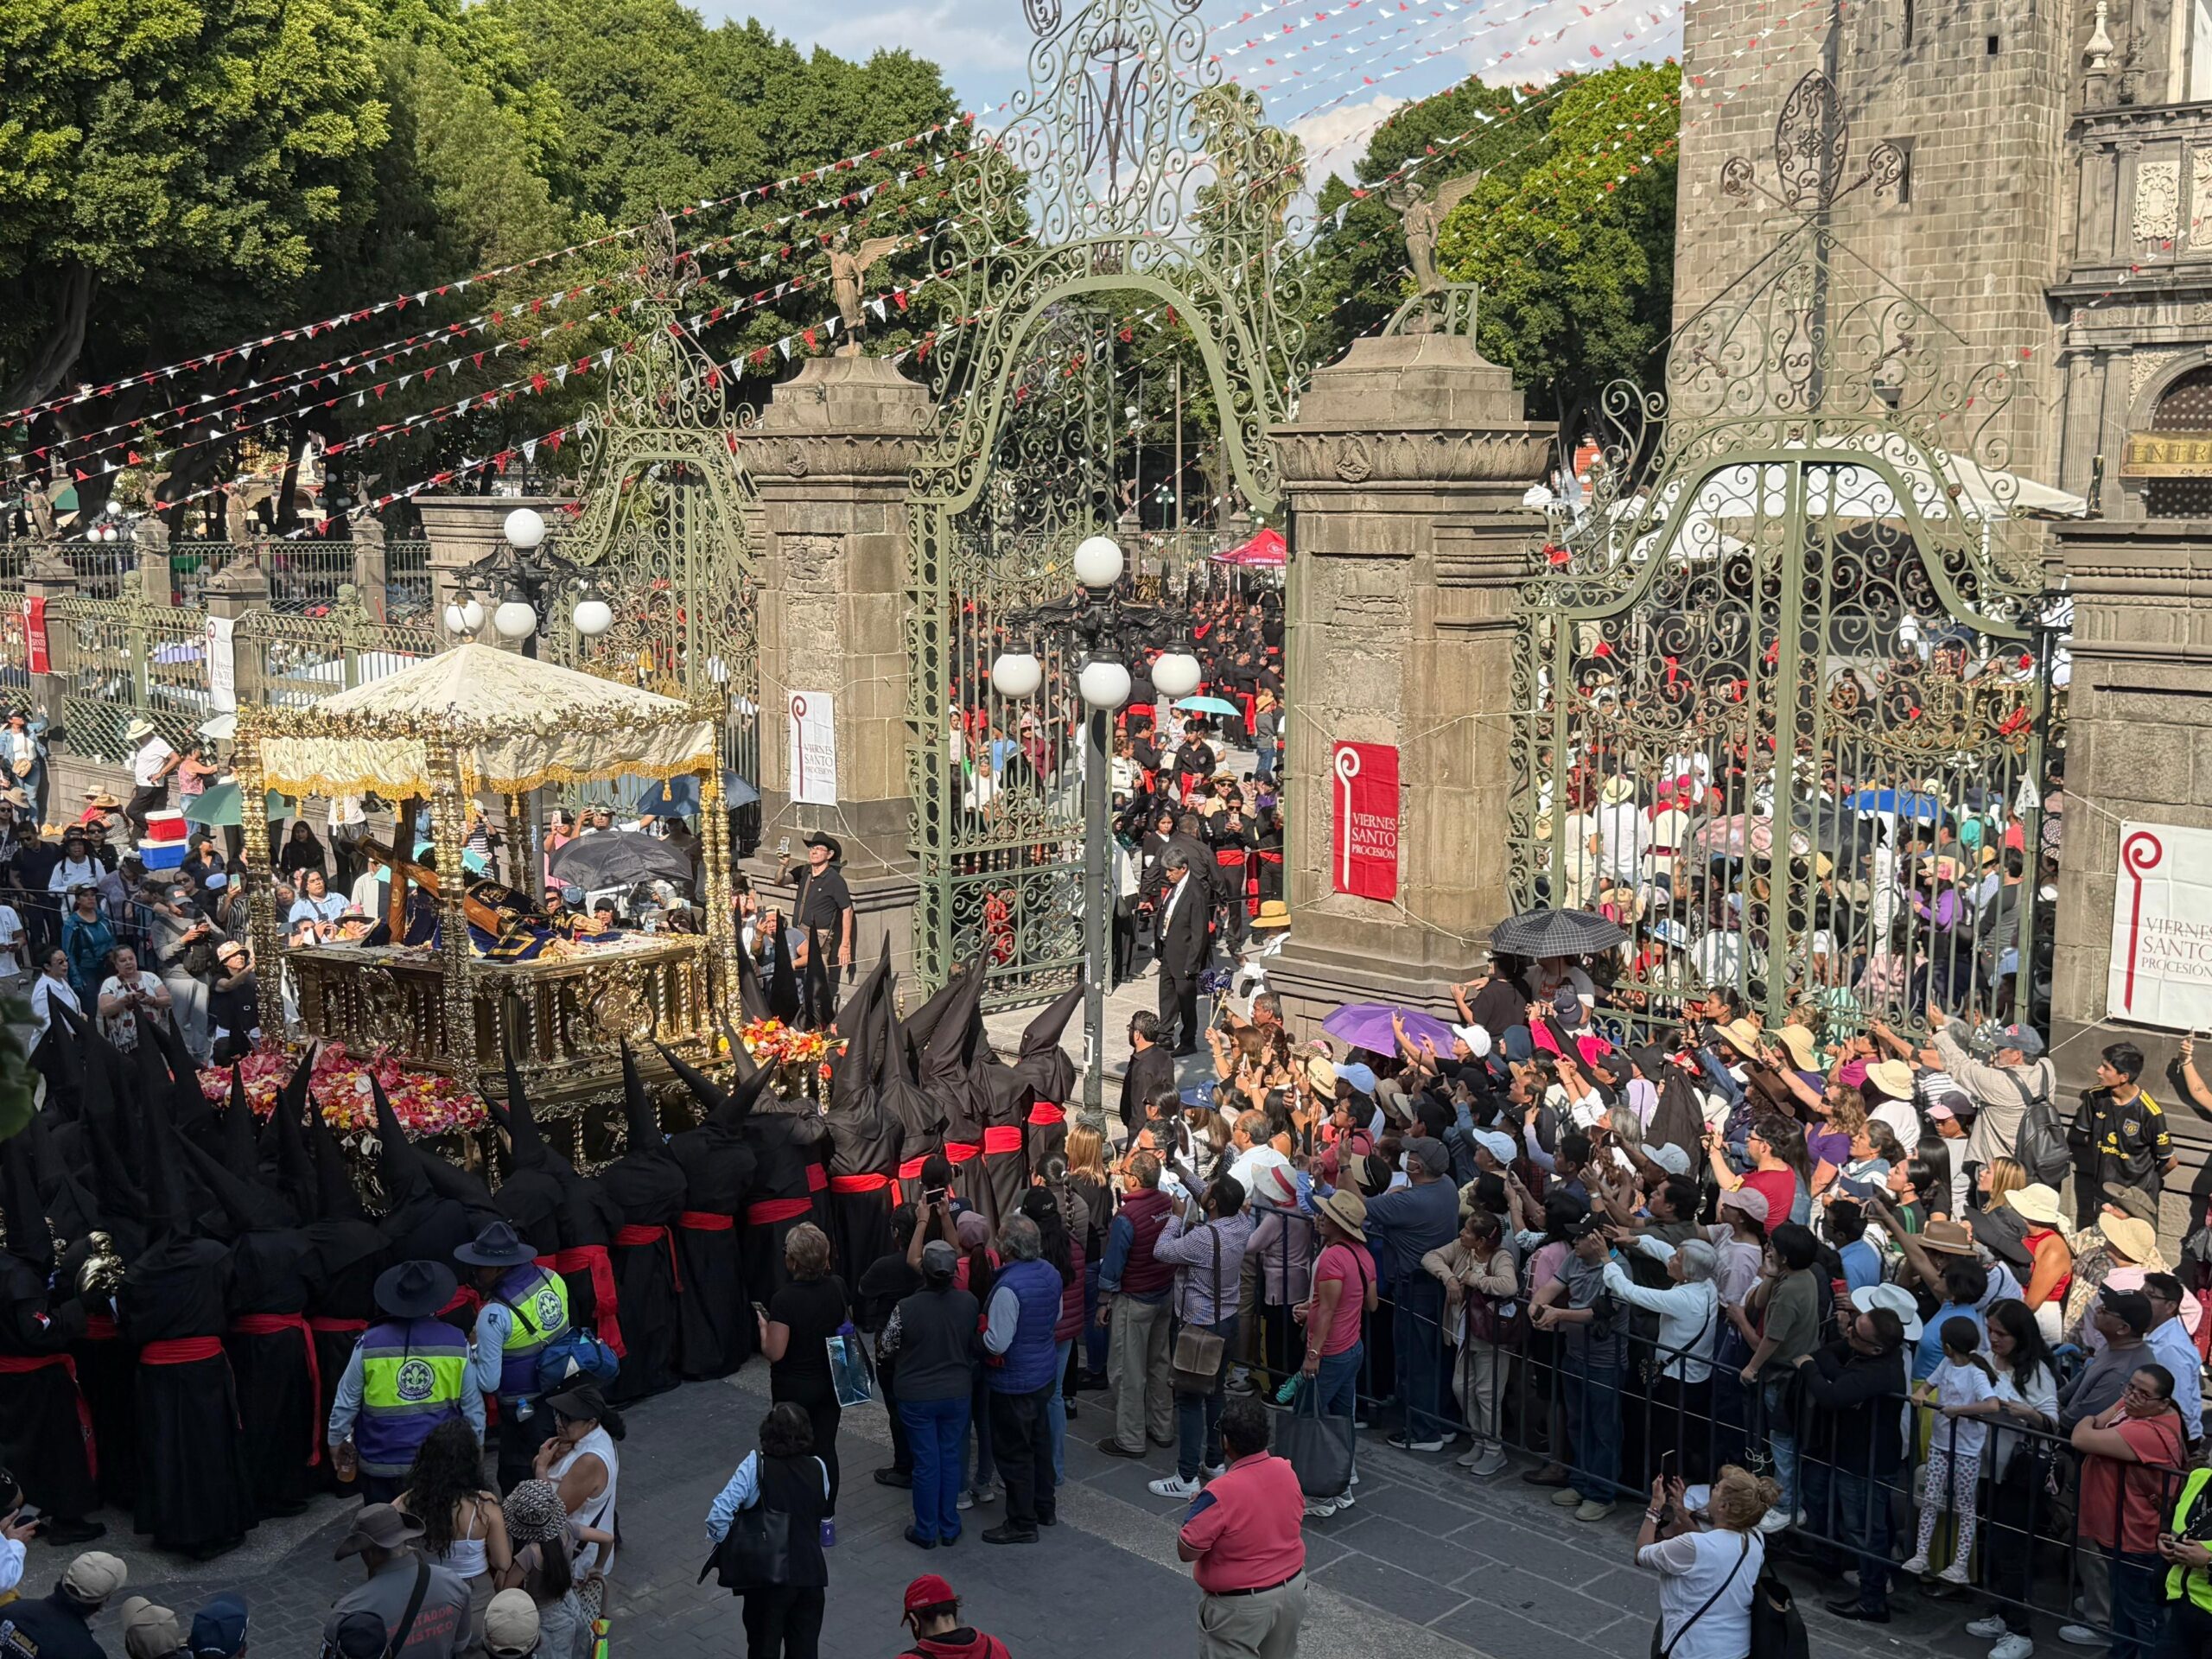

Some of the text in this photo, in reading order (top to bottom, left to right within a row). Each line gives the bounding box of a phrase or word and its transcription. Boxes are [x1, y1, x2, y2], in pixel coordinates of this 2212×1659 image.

[804, 743, 833, 756] VIERNES
[804, 753, 833, 767] SANTO
[1352, 812, 1396, 831] VIERNES
[1351, 827, 1396, 848] SANTO
[1351, 843, 1396, 860] PROCESIÓN
